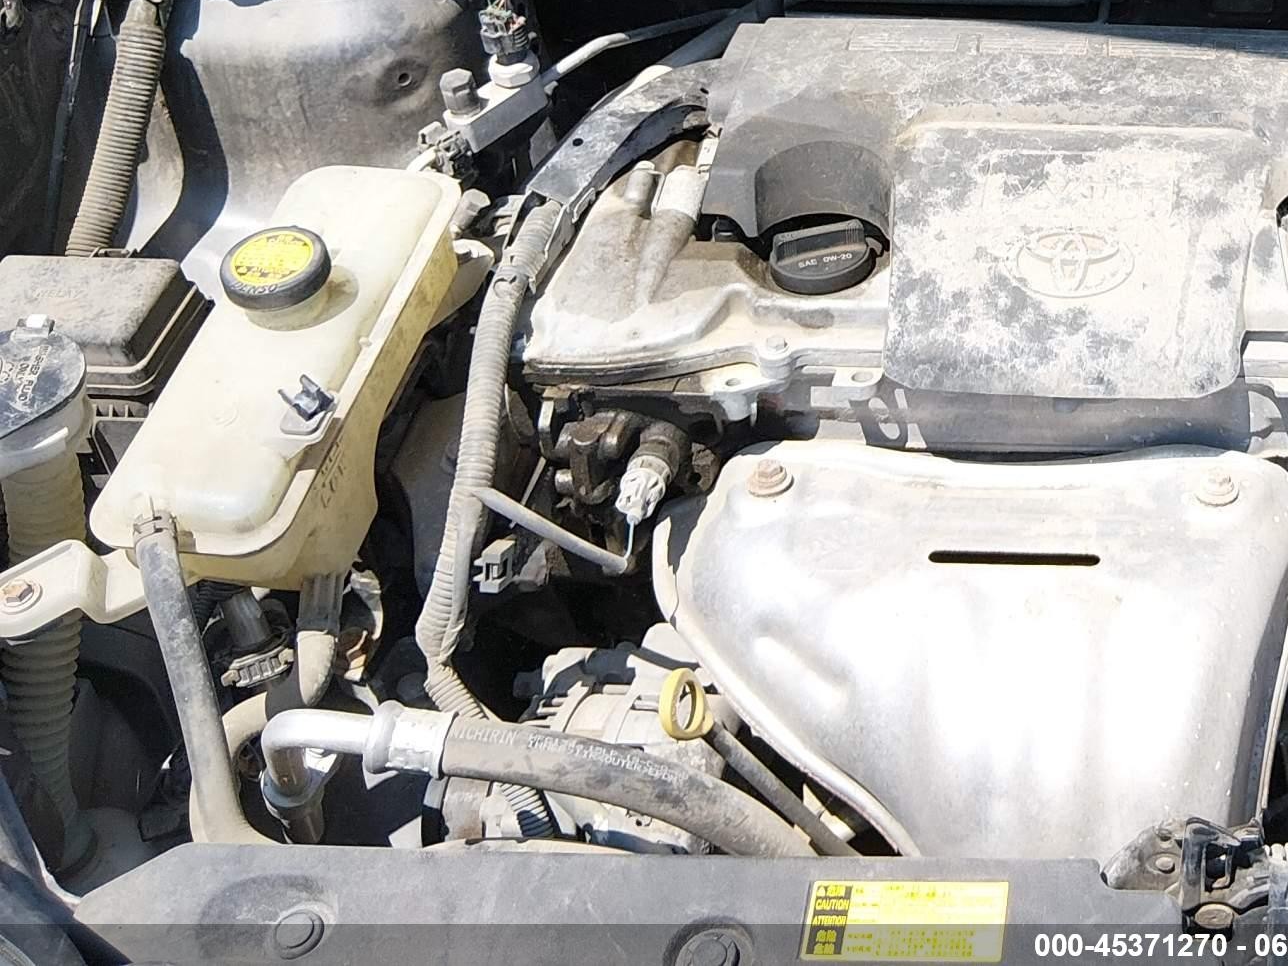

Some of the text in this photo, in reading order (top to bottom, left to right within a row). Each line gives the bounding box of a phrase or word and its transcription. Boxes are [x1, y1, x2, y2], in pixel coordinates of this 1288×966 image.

[798, 253, 853, 268] SAE 0W-20
[231, 282, 278, 295] DENSO
[815, 898, 850, 911] CAUTION
[812, 915, 848, 927] ATTENTION
